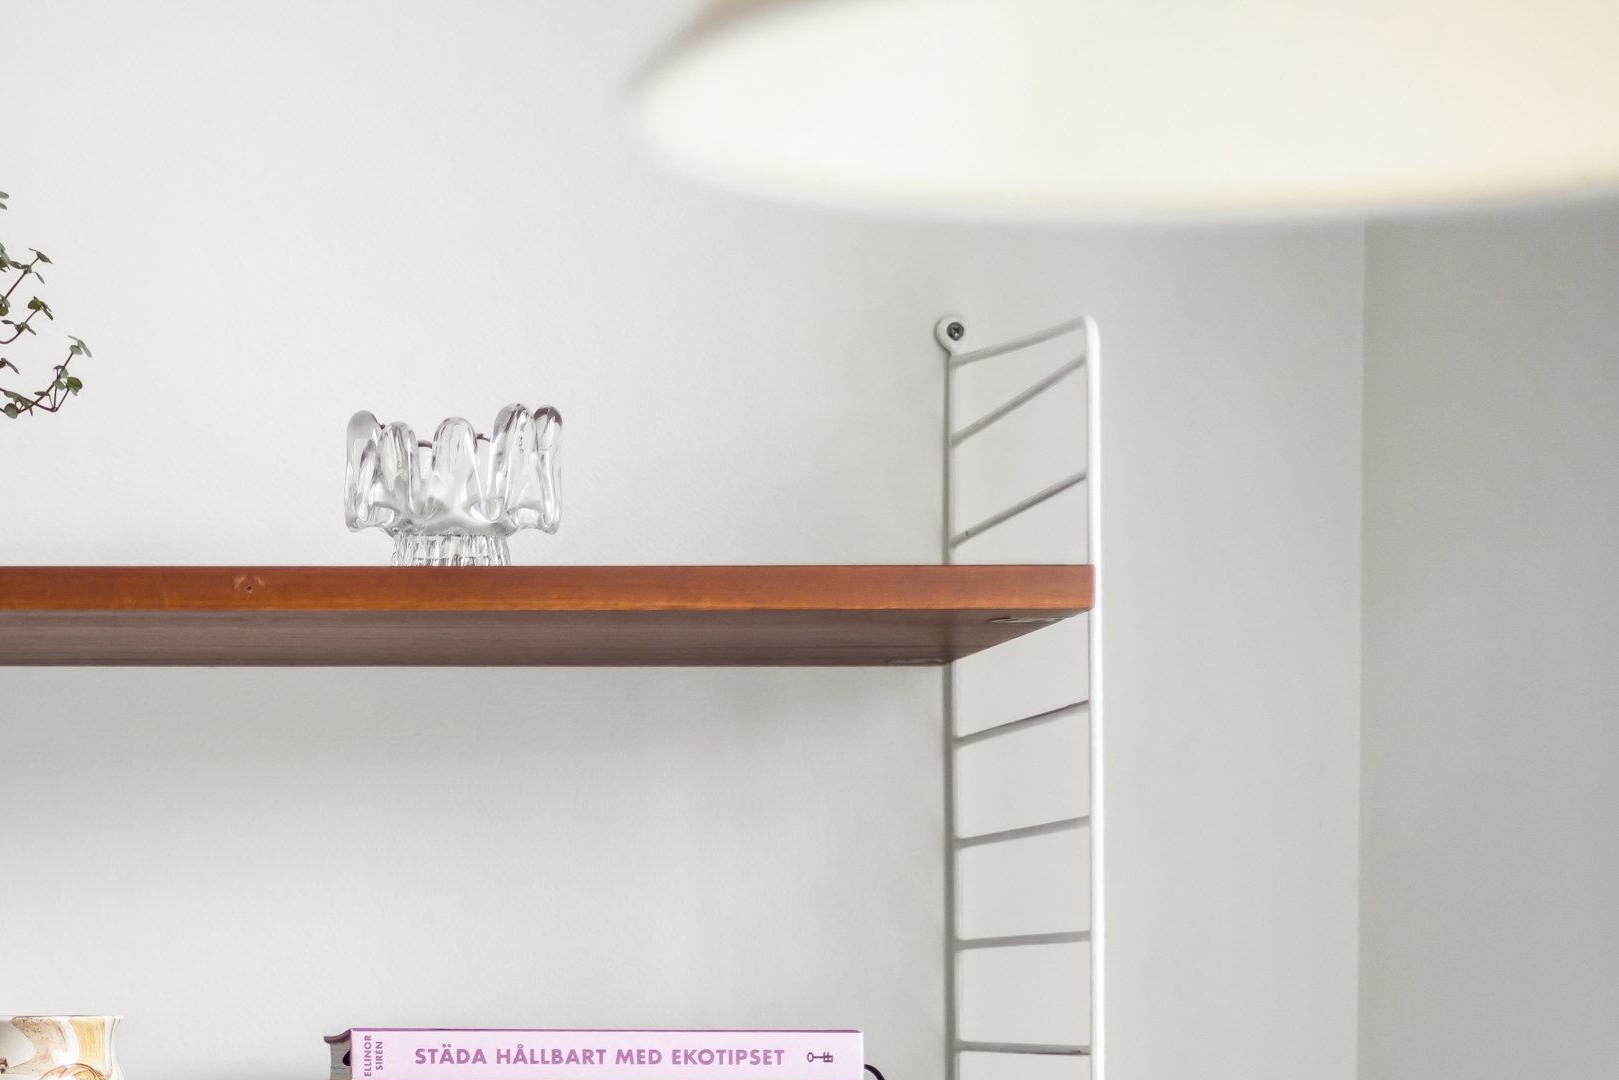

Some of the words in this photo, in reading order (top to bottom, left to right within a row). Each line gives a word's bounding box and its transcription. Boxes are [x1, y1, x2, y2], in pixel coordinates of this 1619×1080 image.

[364, 1035, 372, 1077] ELLINOR
[375, 1041, 384, 1071] SIRÉN
[414, 1043, 488, 1065] STÄDA
[496, 1043, 607, 1065] HÅLLBART
[615, 1048, 663, 1065] MED
[671, 1048, 785, 1066] EKOTIPSET
